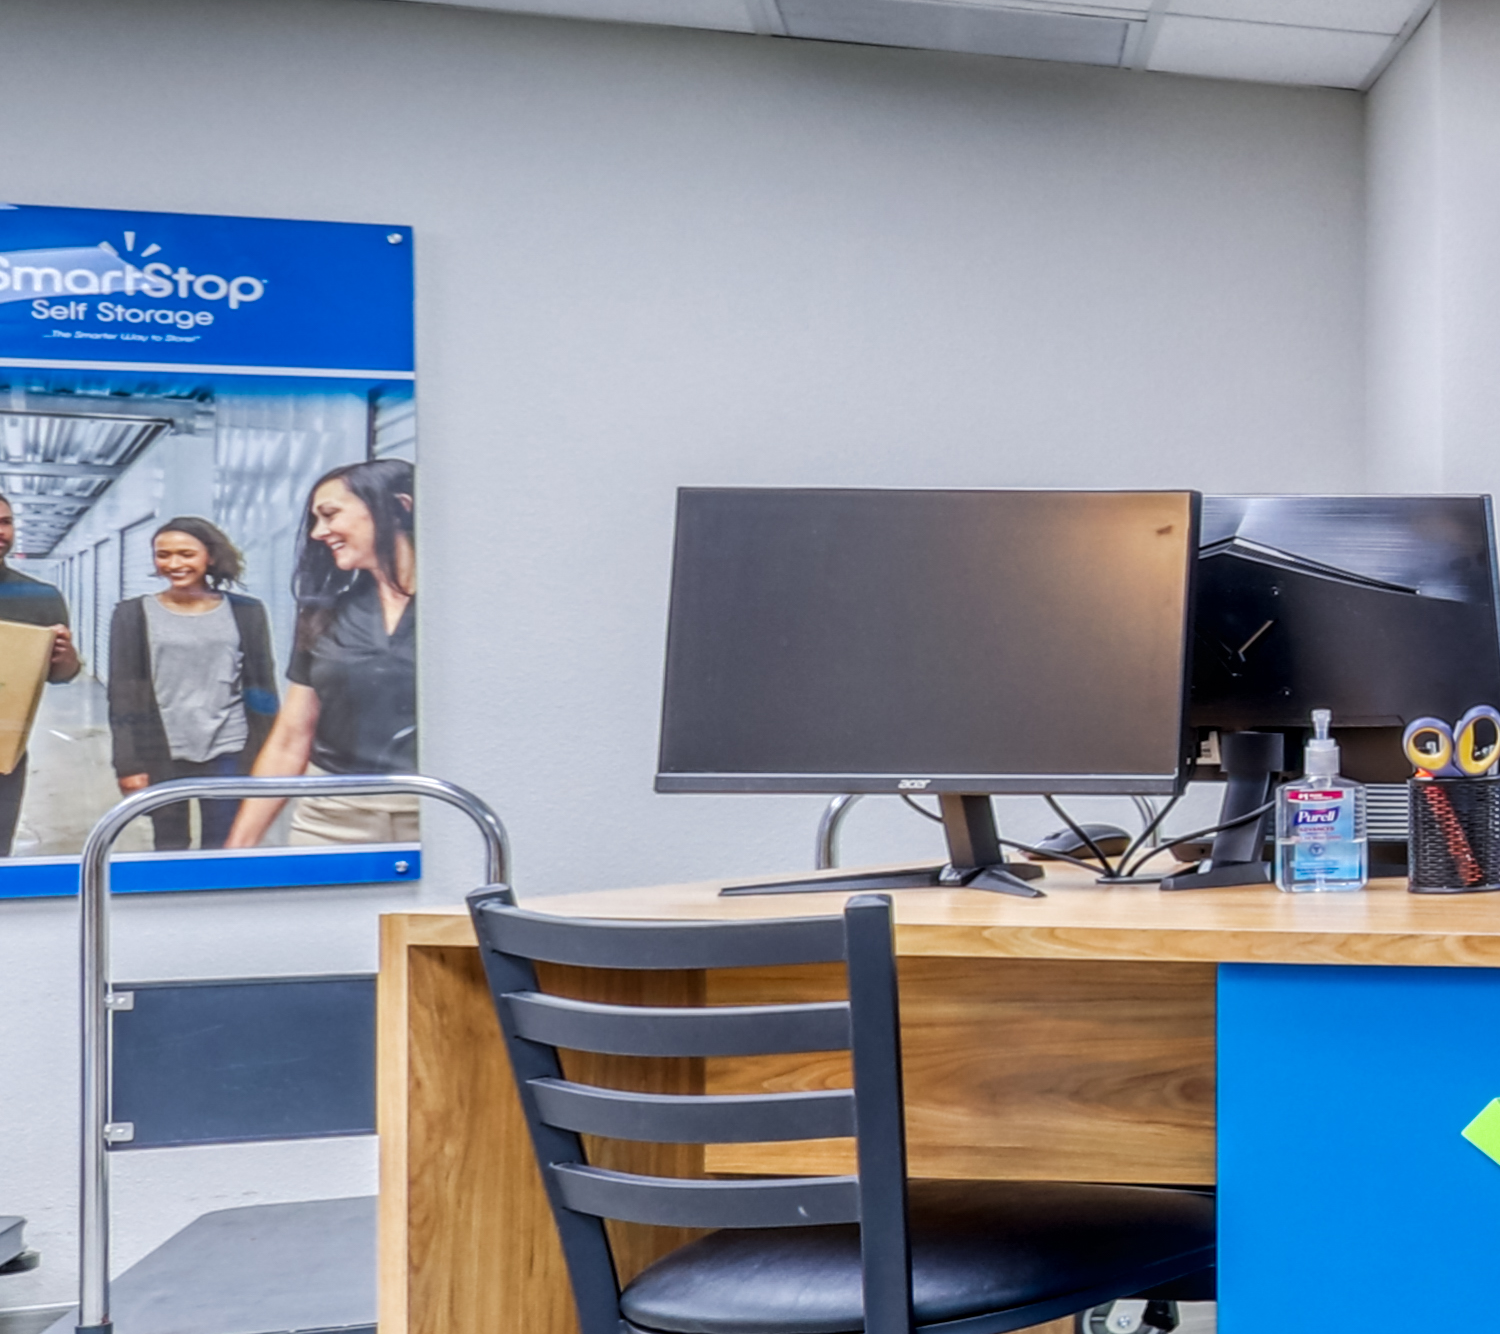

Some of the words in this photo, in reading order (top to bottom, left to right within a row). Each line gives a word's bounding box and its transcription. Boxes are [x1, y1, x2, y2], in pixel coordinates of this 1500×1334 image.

[31, 299, 88, 321] Self
[96, 301, 214, 330] Storage
[898, 779, 931, 789] acer
[1297, 808, 1336, 823] Purell
